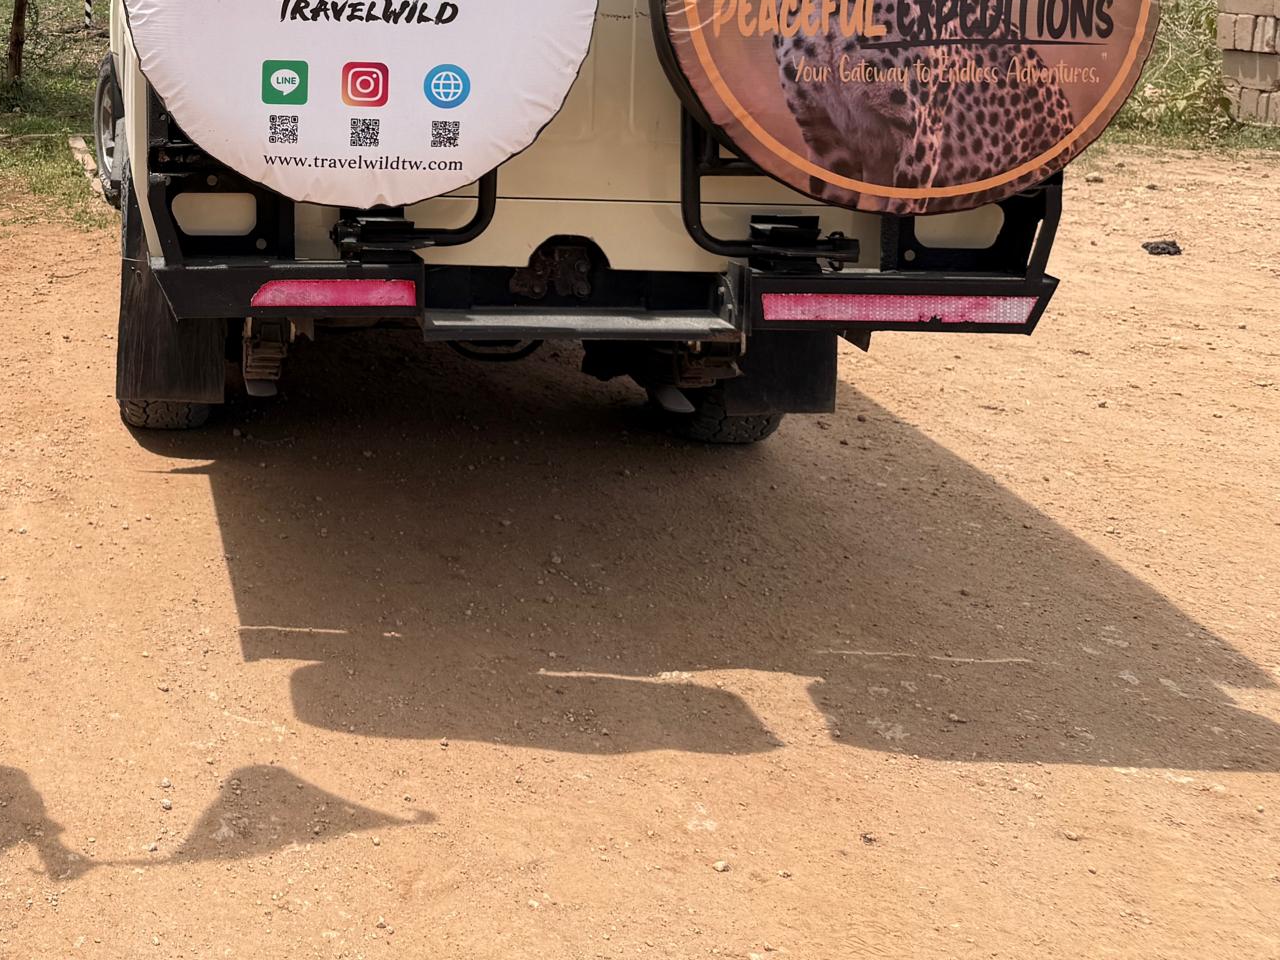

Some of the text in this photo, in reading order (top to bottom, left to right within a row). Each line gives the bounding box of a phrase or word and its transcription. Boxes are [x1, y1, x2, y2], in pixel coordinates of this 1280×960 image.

[276, 76, 297, 85] LINE
[792, 55, 832, 83] Your
[839, 54, 910, 92] Gateway
[913, 58, 931, 83] to
[939, 54, 999, 83] Endless
[263, 155, 464, 171] www.travelwildtw.com
